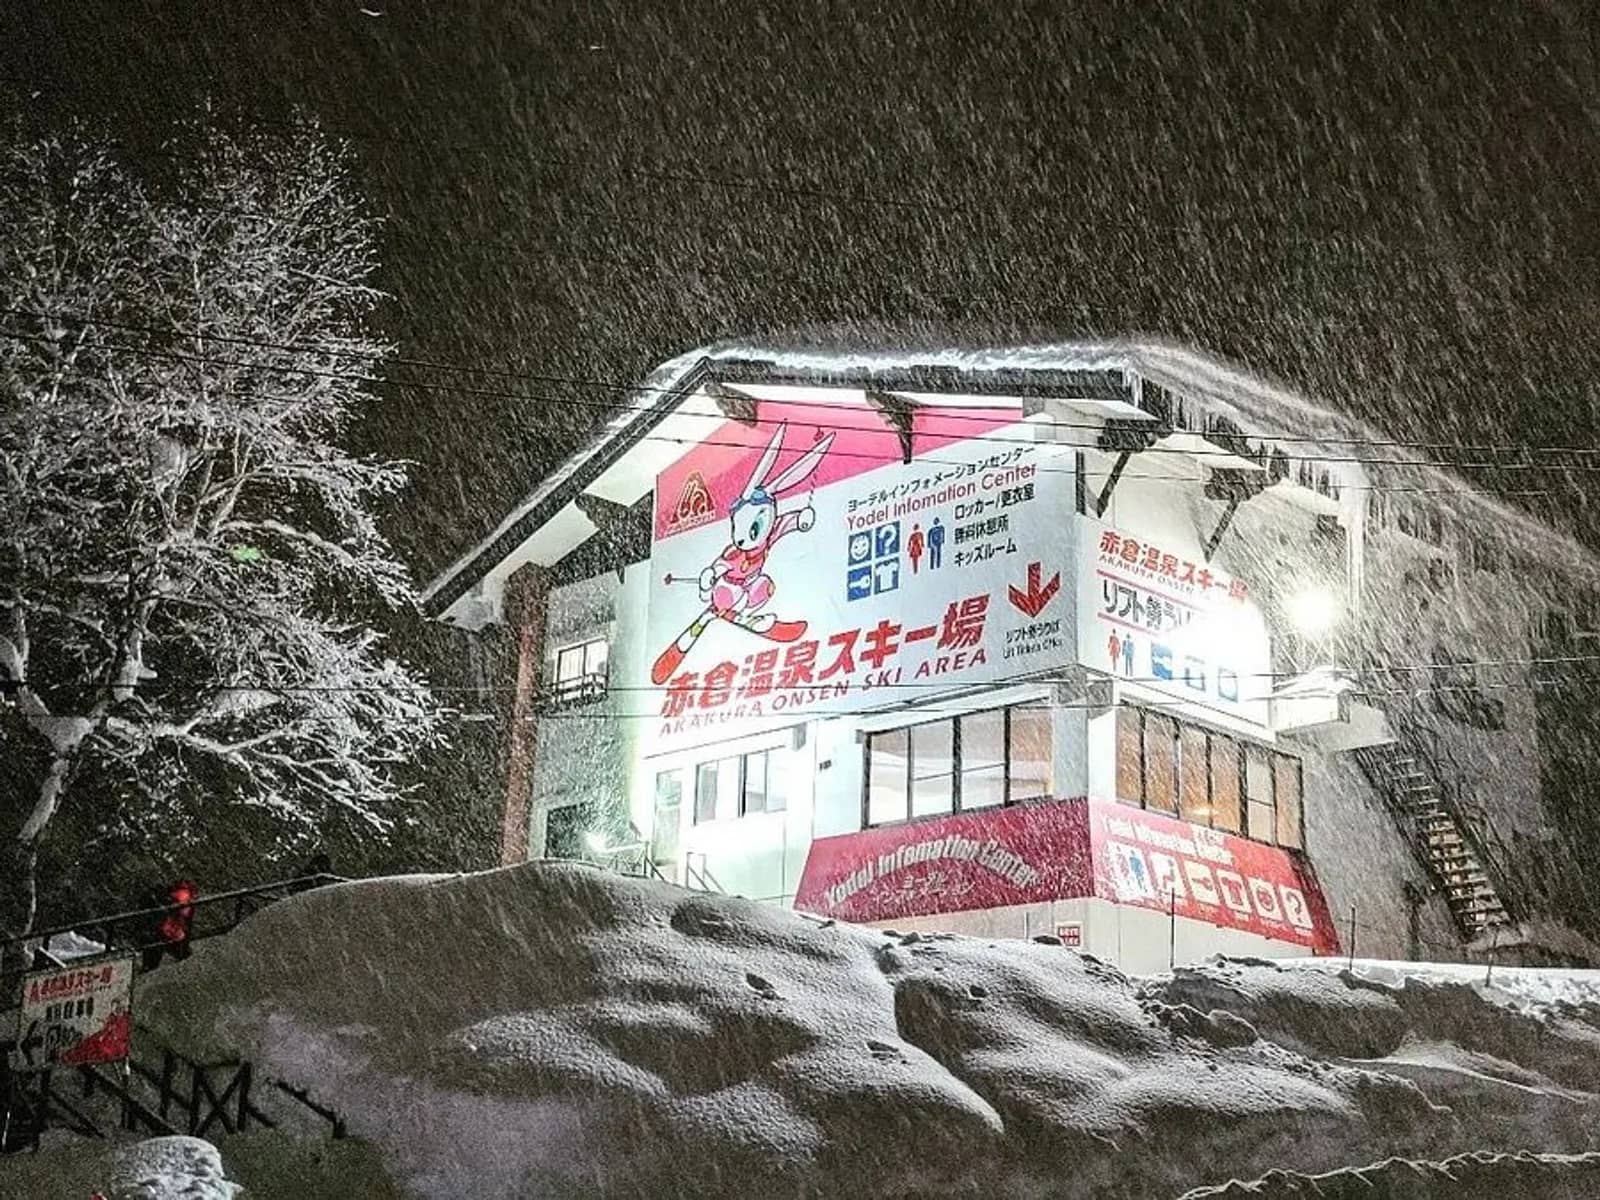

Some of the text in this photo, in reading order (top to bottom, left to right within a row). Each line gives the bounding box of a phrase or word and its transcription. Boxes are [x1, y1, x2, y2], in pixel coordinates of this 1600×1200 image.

[847, 463, 1037, 530] Yodel Infomation Center
[848, 447, 1036, 512] ヨーデルインフォメーションセンター
[954, 538, 1018, 567] キッズルーム
[1099, 531, 1248, 600] 赤倉温泉スキー場
[660, 593, 991, 717] 赤倉温泉スキー場
[659, 702, 763, 737] AKAKURA
[772, 679, 850, 710] ONSEN
[862, 668, 901, 692] SKI
[915, 648, 987, 679] AREA
